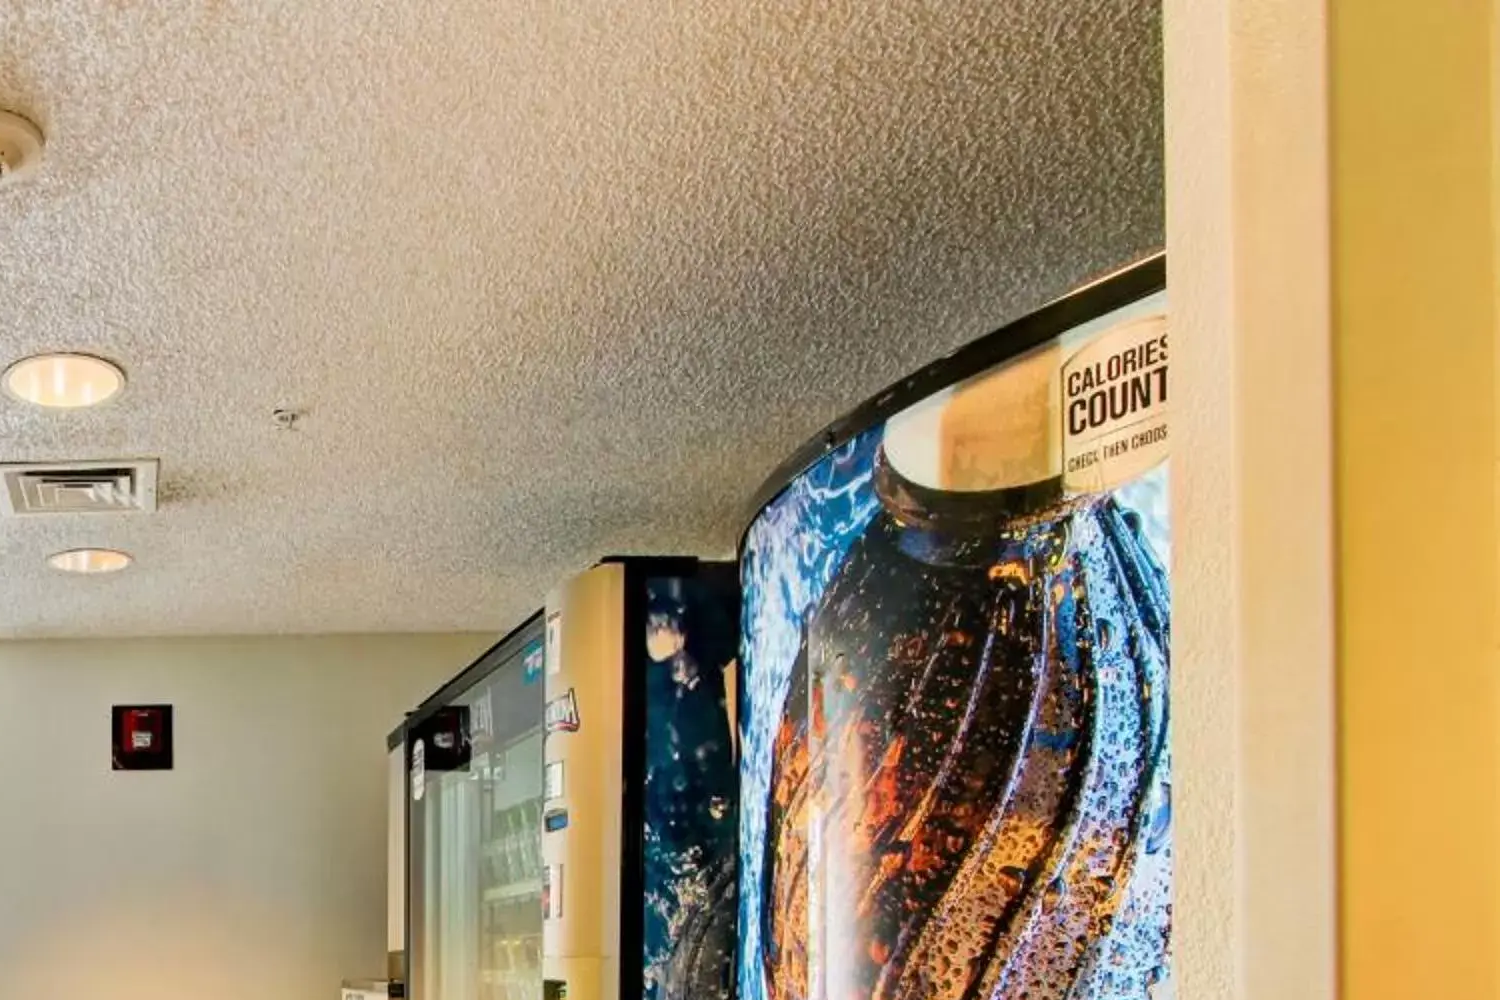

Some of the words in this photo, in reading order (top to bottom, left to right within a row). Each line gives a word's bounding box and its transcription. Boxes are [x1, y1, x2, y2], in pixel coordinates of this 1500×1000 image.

[1068, 334, 1168, 397] CALORIES
[1069, 366, 1168, 435] COUNT
[1103, 439, 1128, 460] THEN
